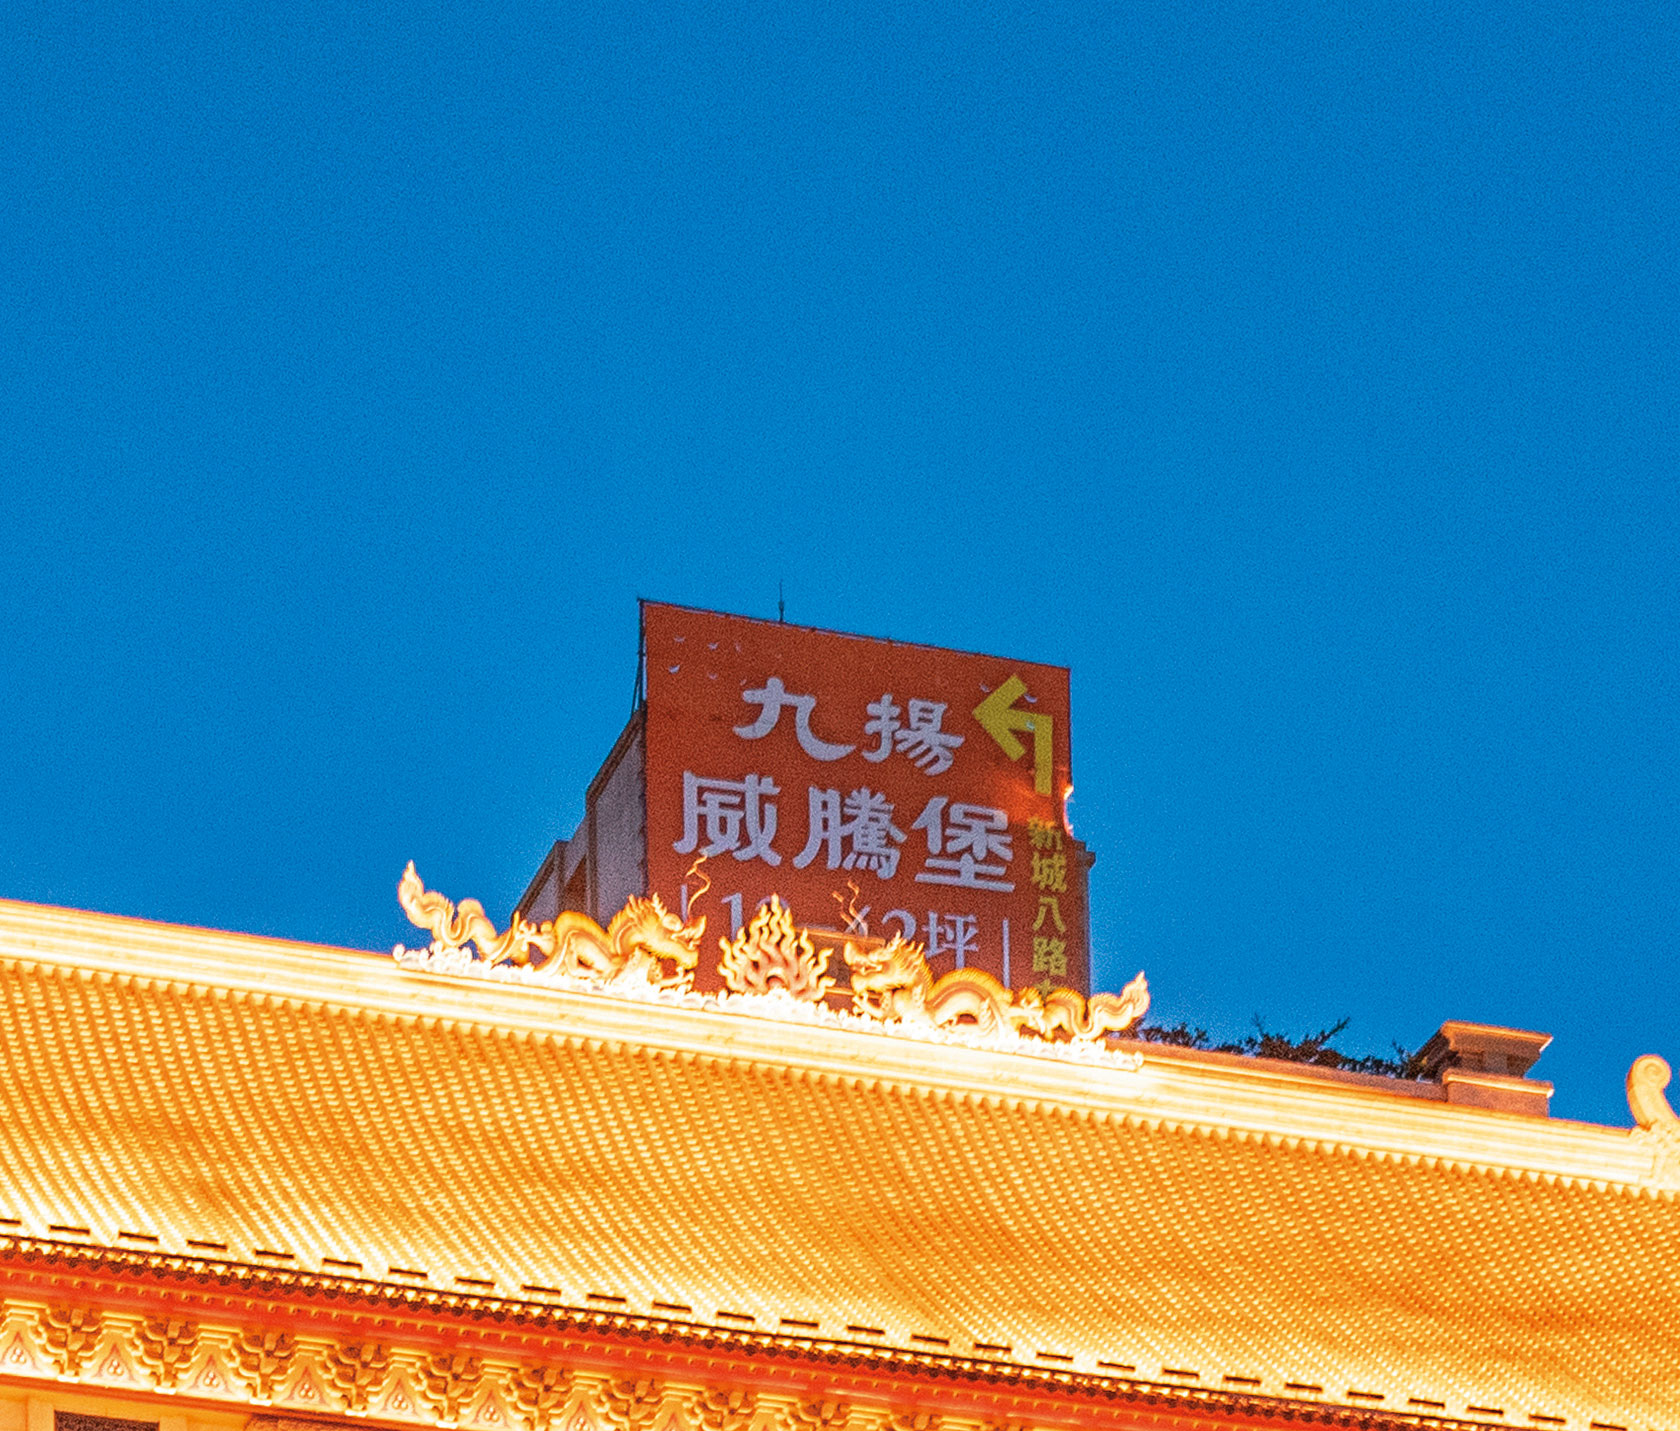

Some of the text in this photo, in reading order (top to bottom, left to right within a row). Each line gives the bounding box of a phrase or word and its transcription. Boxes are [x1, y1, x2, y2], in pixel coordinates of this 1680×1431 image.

[733, 677, 965, 776] 九揚
[671, 770, 1016, 892] 威騰堡
